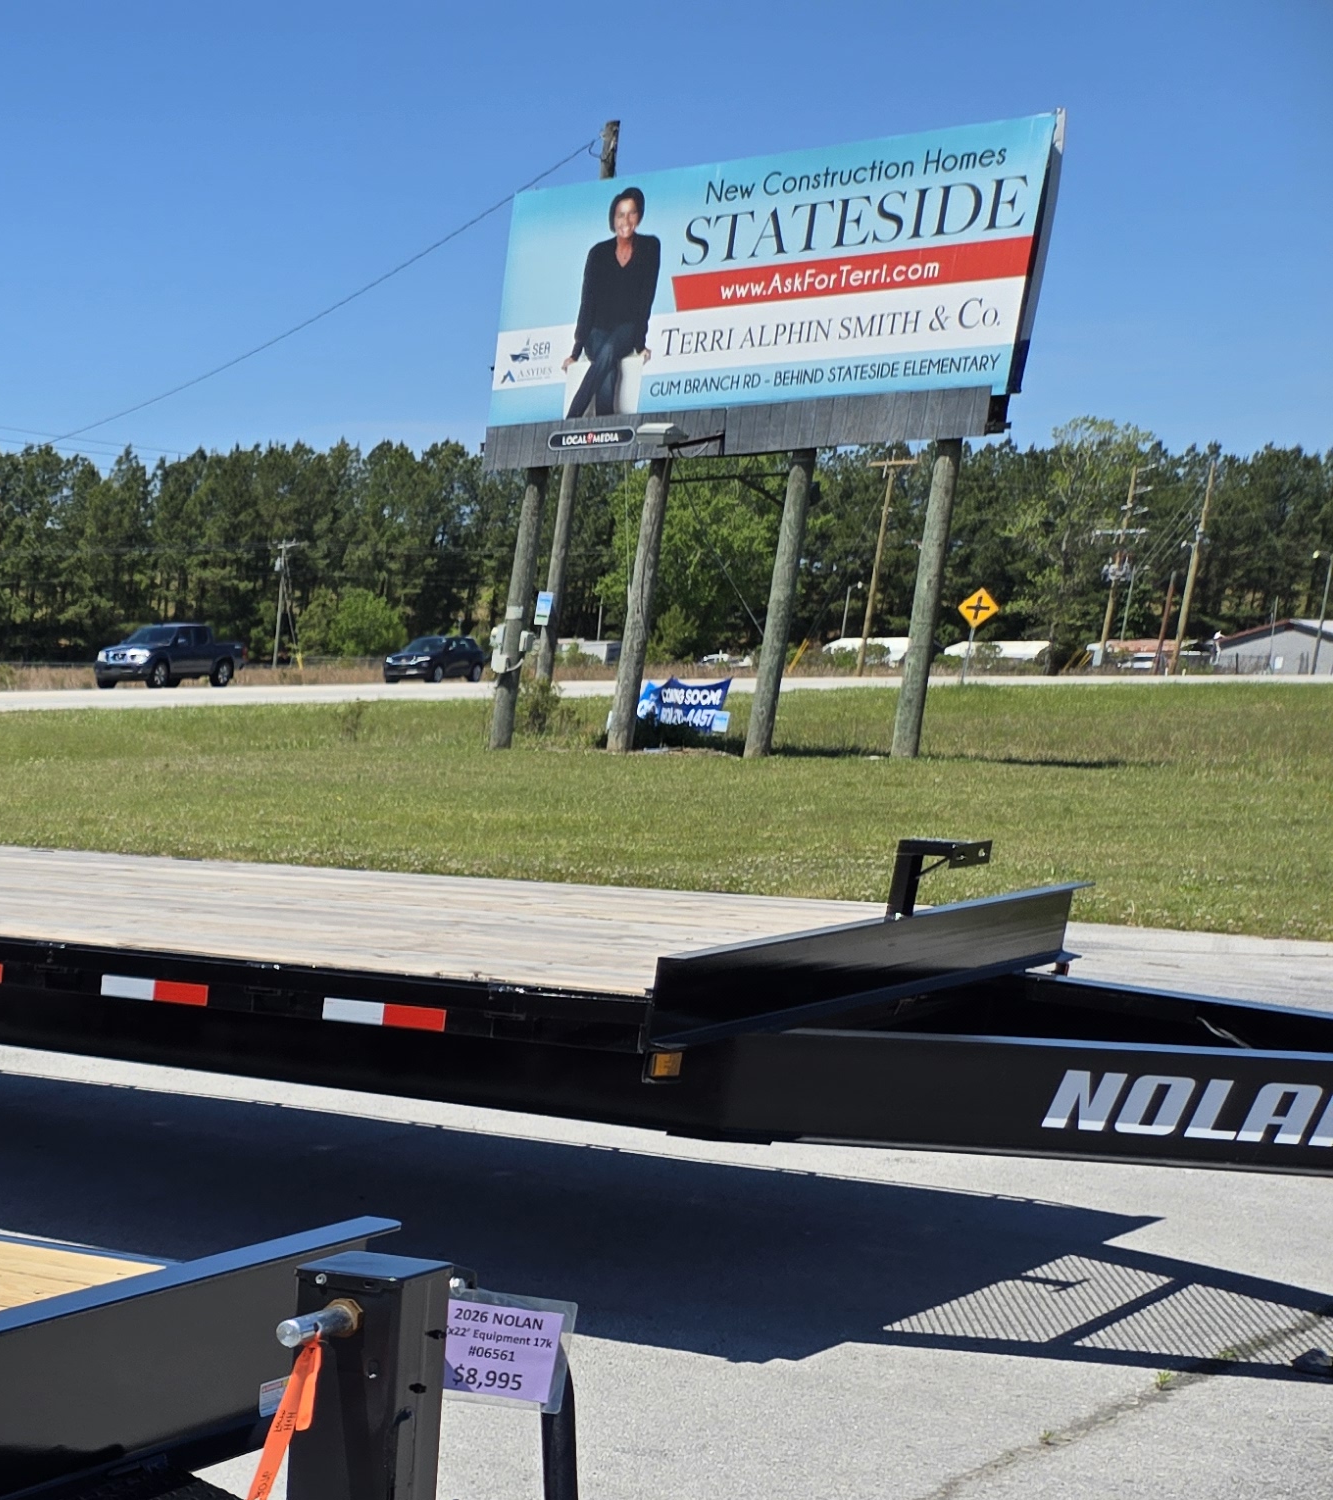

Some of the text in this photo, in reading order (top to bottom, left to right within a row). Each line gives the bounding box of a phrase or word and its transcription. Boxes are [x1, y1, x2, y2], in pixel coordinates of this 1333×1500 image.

[705, 147, 1007, 205] New Construction Homes
[681, 175, 1029, 266] STATESIDE
[739, 318, 833, 350] ALPHIN
[838, 309, 922, 341] SMITH
[928, 304, 952, 332] &
[650, 379, 681, 398] GUM
[684, 374, 740, 395] BRANCH
[743, 372, 761, 390] RD
[773, 368, 824, 388] BEHIND
[827, 361, 900, 383] STATESIDE
[903, 353, 1001, 378] ELEMENTARY
[561, 432, 619, 446] LOCAL MEDIA
[453, 1308, 544, 1331] 2026 NOLAN
[446, 1325, 553, 1349] x22' Equipment 17k
[468, 1345, 516, 1362] #06561
[452, 1363, 523, 1391] $8,995
